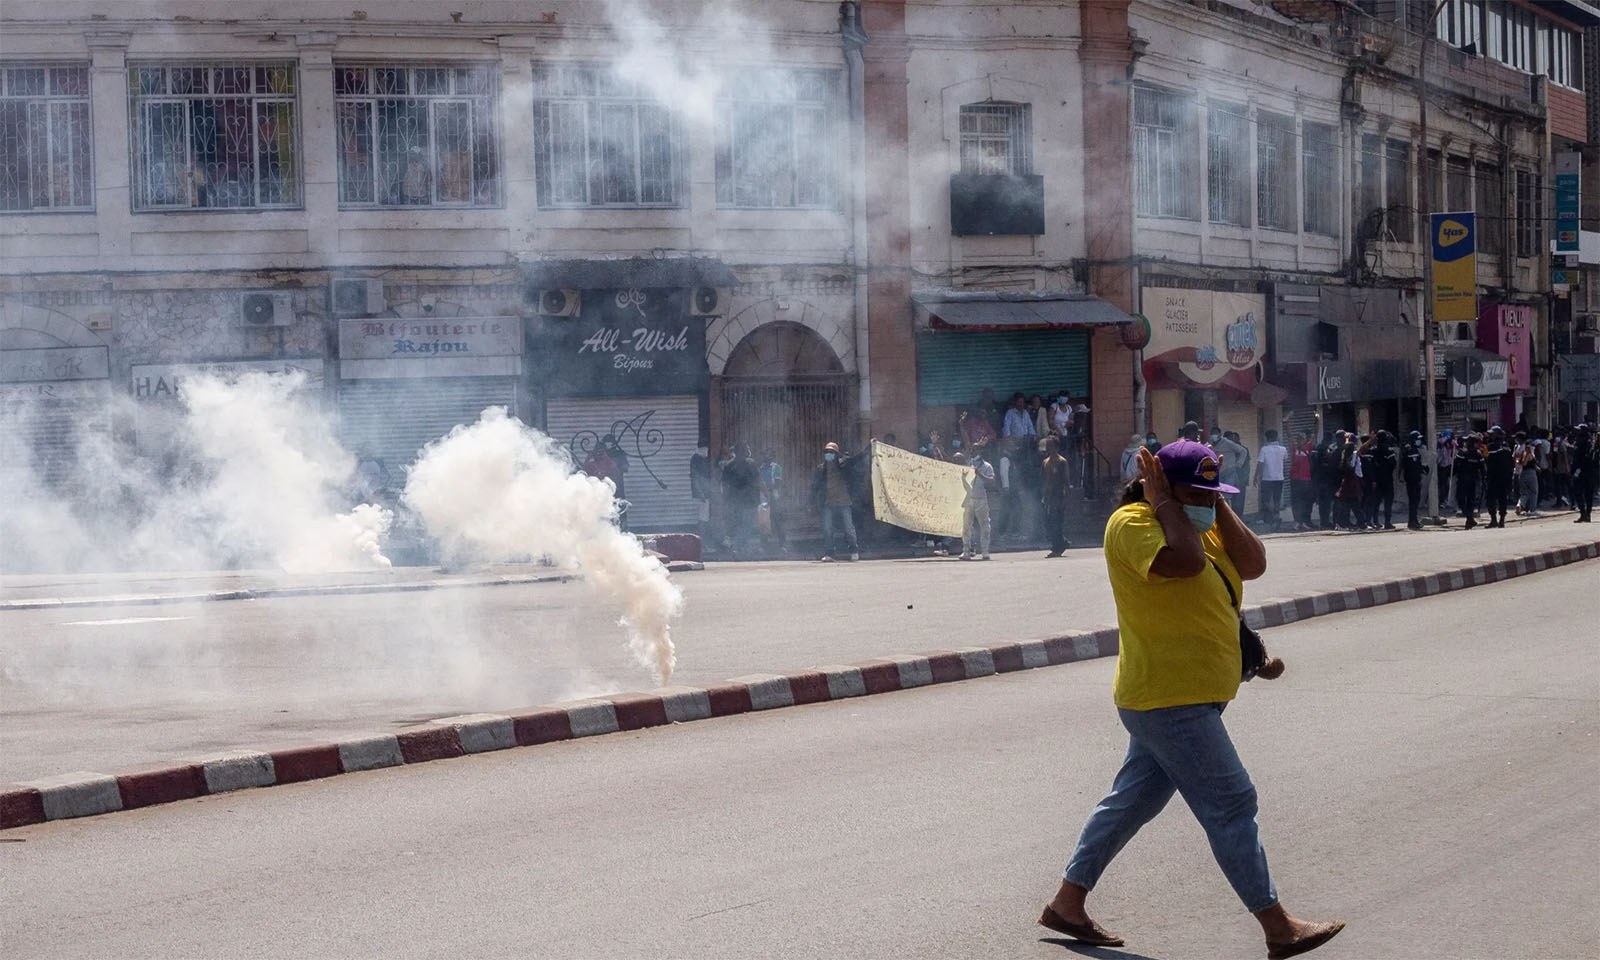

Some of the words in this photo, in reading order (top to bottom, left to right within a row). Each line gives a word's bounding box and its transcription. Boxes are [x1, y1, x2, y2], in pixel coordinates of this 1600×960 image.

[1443, 228, 1464, 240] yas
[1165, 296, 1185, 307] SNACK
[1165, 309, 1188, 321] GLACIER
[361, 321, 502, 338] Bijouterie
[1165, 323, 1198, 334] PATISSERIE
[392, 339, 469, 354] Rajou
[613, 354, 654, 373] Bijoux
